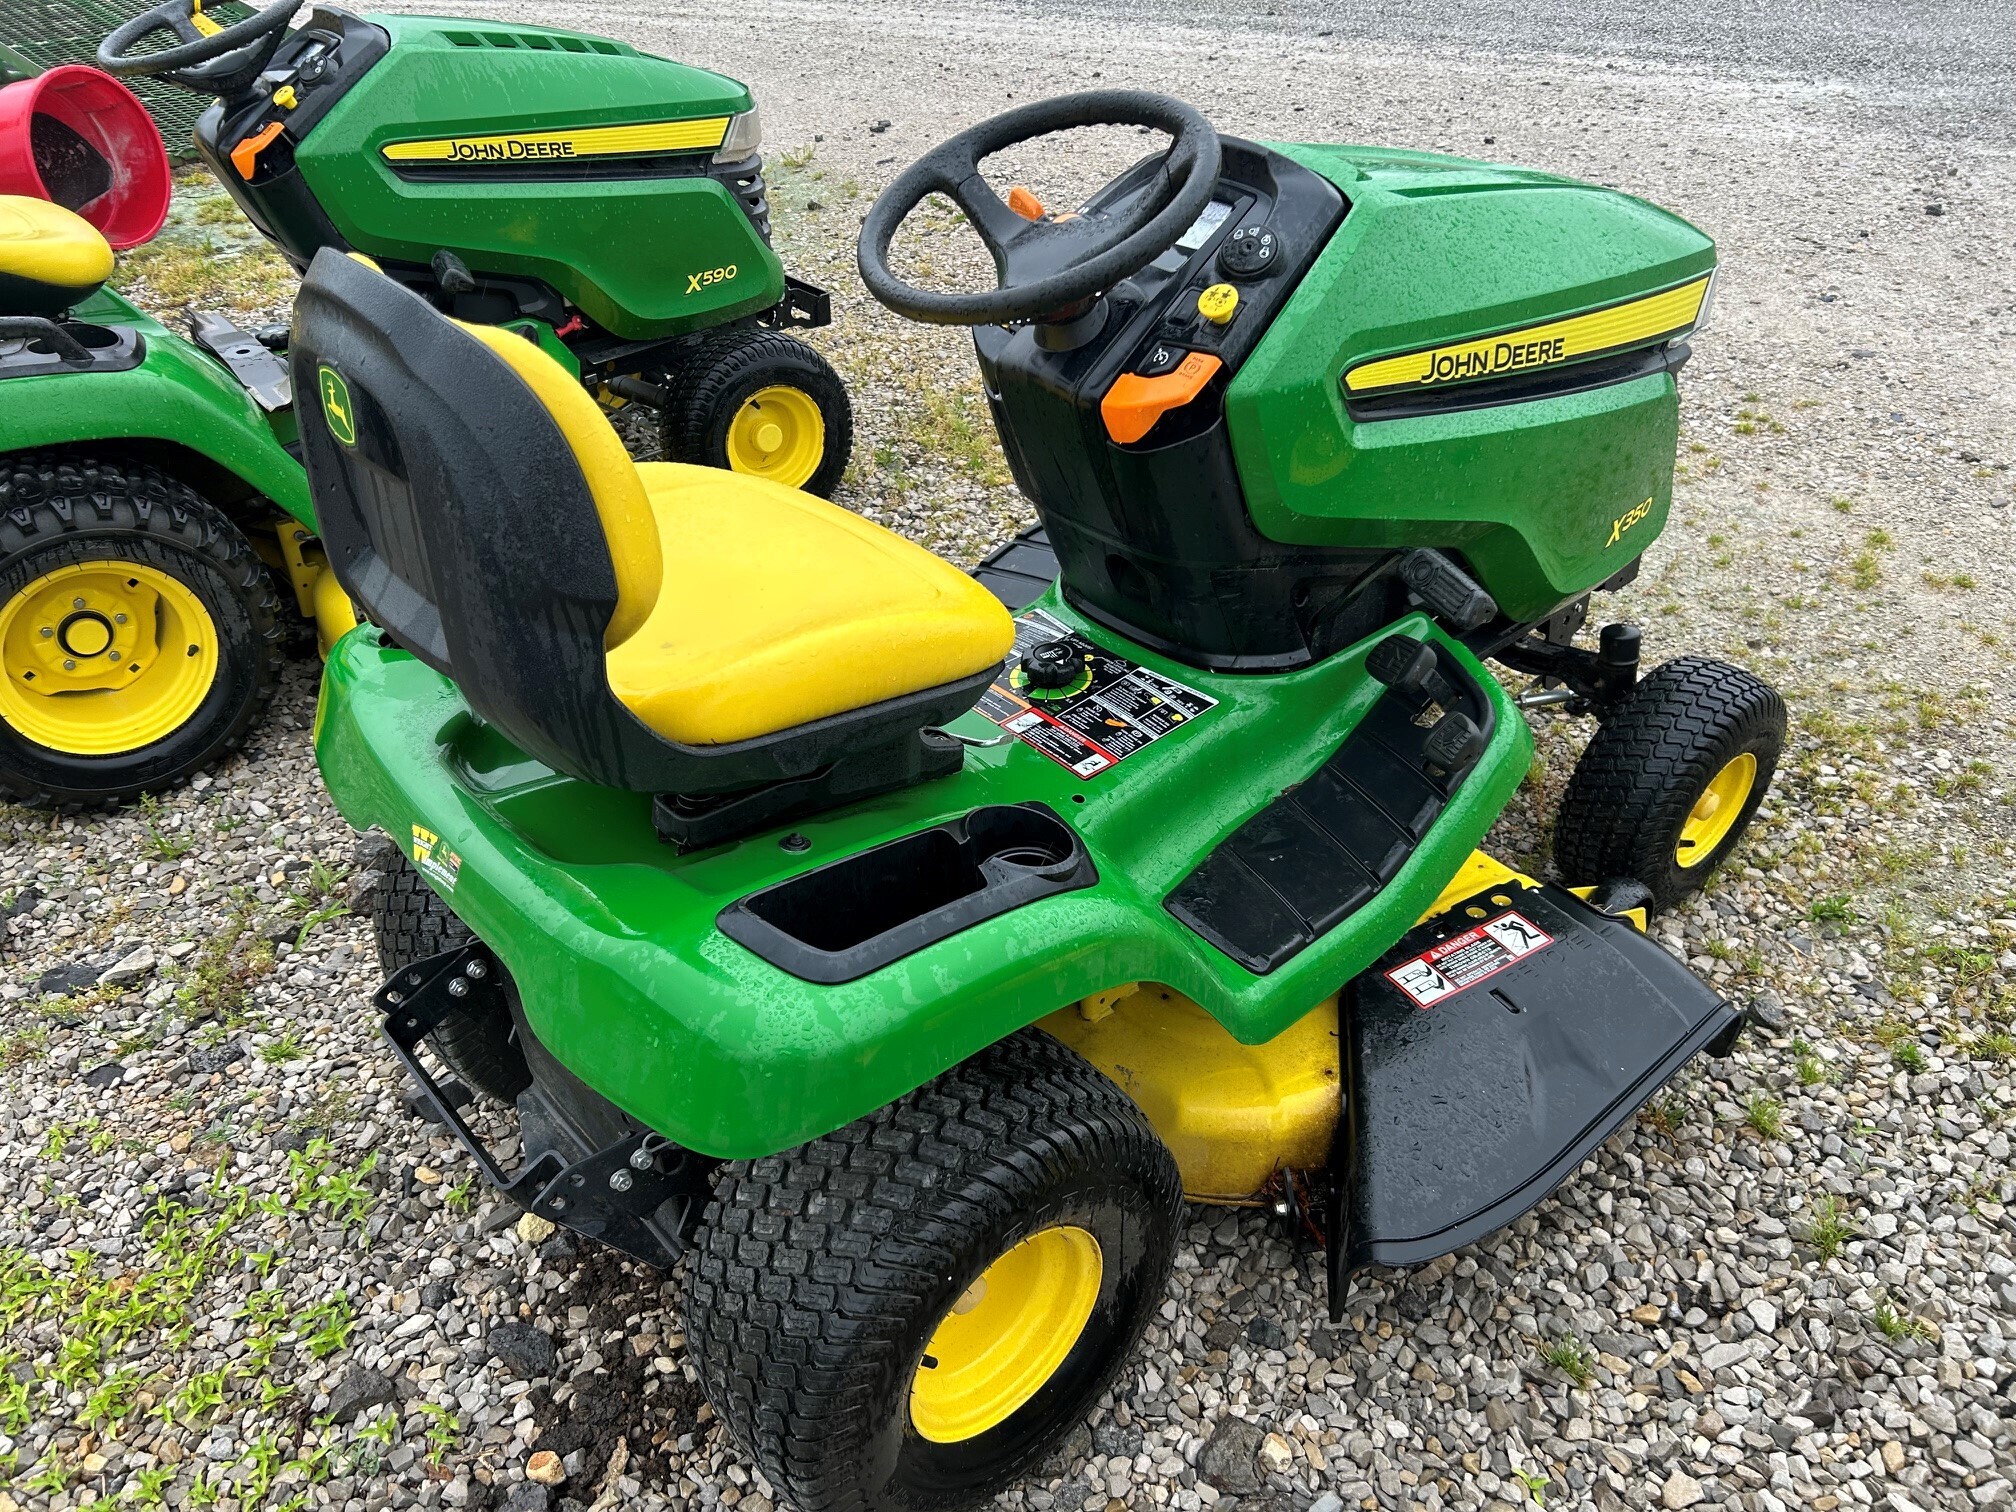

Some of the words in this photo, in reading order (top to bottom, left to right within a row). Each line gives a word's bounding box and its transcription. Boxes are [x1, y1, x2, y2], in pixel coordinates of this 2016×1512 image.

[447, 141, 506, 160] JOHN
[507, 140, 576, 158] DEERE
[684, 264, 738, 295] X590
[1420, 352, 1489, 383] JOHN
[1493, 337, 1565, 371] DEERE
[1604, 496, 1653, 549] X350
[1437, 932, 1481, 954] DANGER
